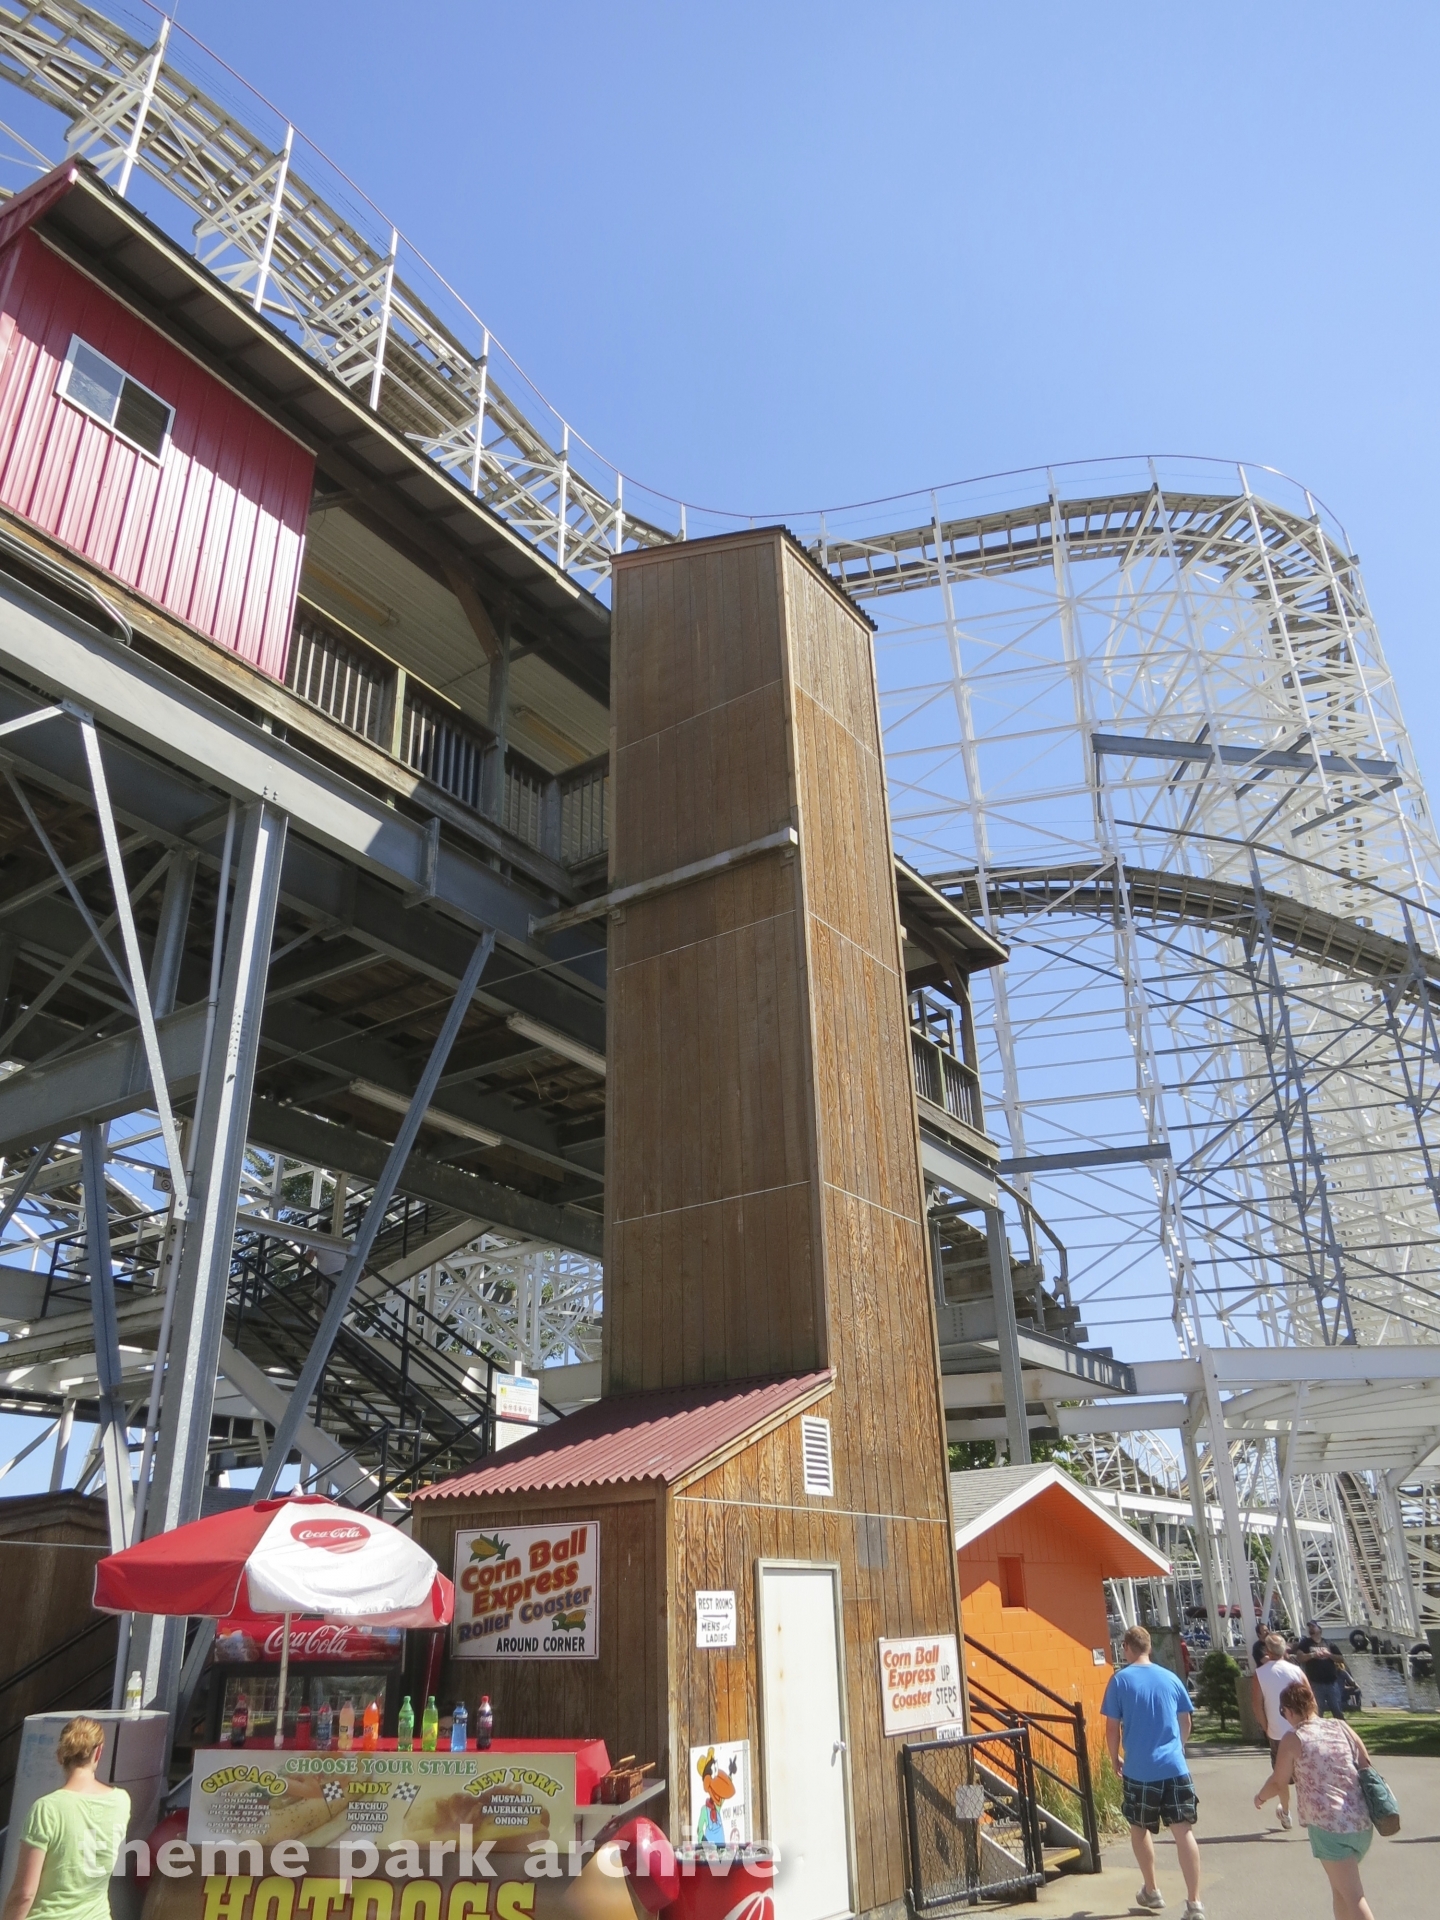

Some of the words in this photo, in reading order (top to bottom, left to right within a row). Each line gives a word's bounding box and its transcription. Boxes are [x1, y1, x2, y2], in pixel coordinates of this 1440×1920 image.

[461, 1557, 522, 1593] Corn
[528, 1526, 588, 1573] Ball
[472, 1561, 580, 1618] Express
[698, 1597, 713, 1610] REST
[715, 1597, 733, 1610] ROOMS
[457, 1611, 513, 1644] Roller
[519, 1585, 592, 1624] Coaster
[496, 1637, 539, 1652] AROUND
[543, 1636, 585, 1652] CORNER
[705, 1633, 728, 1643] LADIES
[883, 1649, 912, 1669] Corn
[915, 1644, 940, 1666] Ball
[888, 1667, 936, 1690] Express
[940, 1664, 951, 1682] UP
[892, 1689, 933, 1711] Coaster
[935, 1685, 958, 1705] STEPS
[285, 1757, 358, 1774] CHOOSE
[361, 1759, 414, 1775] YOUR
[418, 1760, 477, 1776] STYLE
[200, 1765, 288, 1796] CHICAGO
[462, 1768, 507, 1797] NEW
[509, 1766, 564, 1798] YORK
[348, 1782, 392, 1795] INDY
[348, 1802, 389, 1811] KETCHUP
[491, 1794, 534, 1804] MUSTARD
[347, 1812, 389, 1822] MUSTARD
[482, 1805, 542, 1815] SAUERKRAUT
[722, 1808, 731, 1818] YOU
[733, 1804, 745, 1817] MUST
[350, 1823, 384, 1832] ONIONS
[494, 1816, 530, 1826] ONIONS
